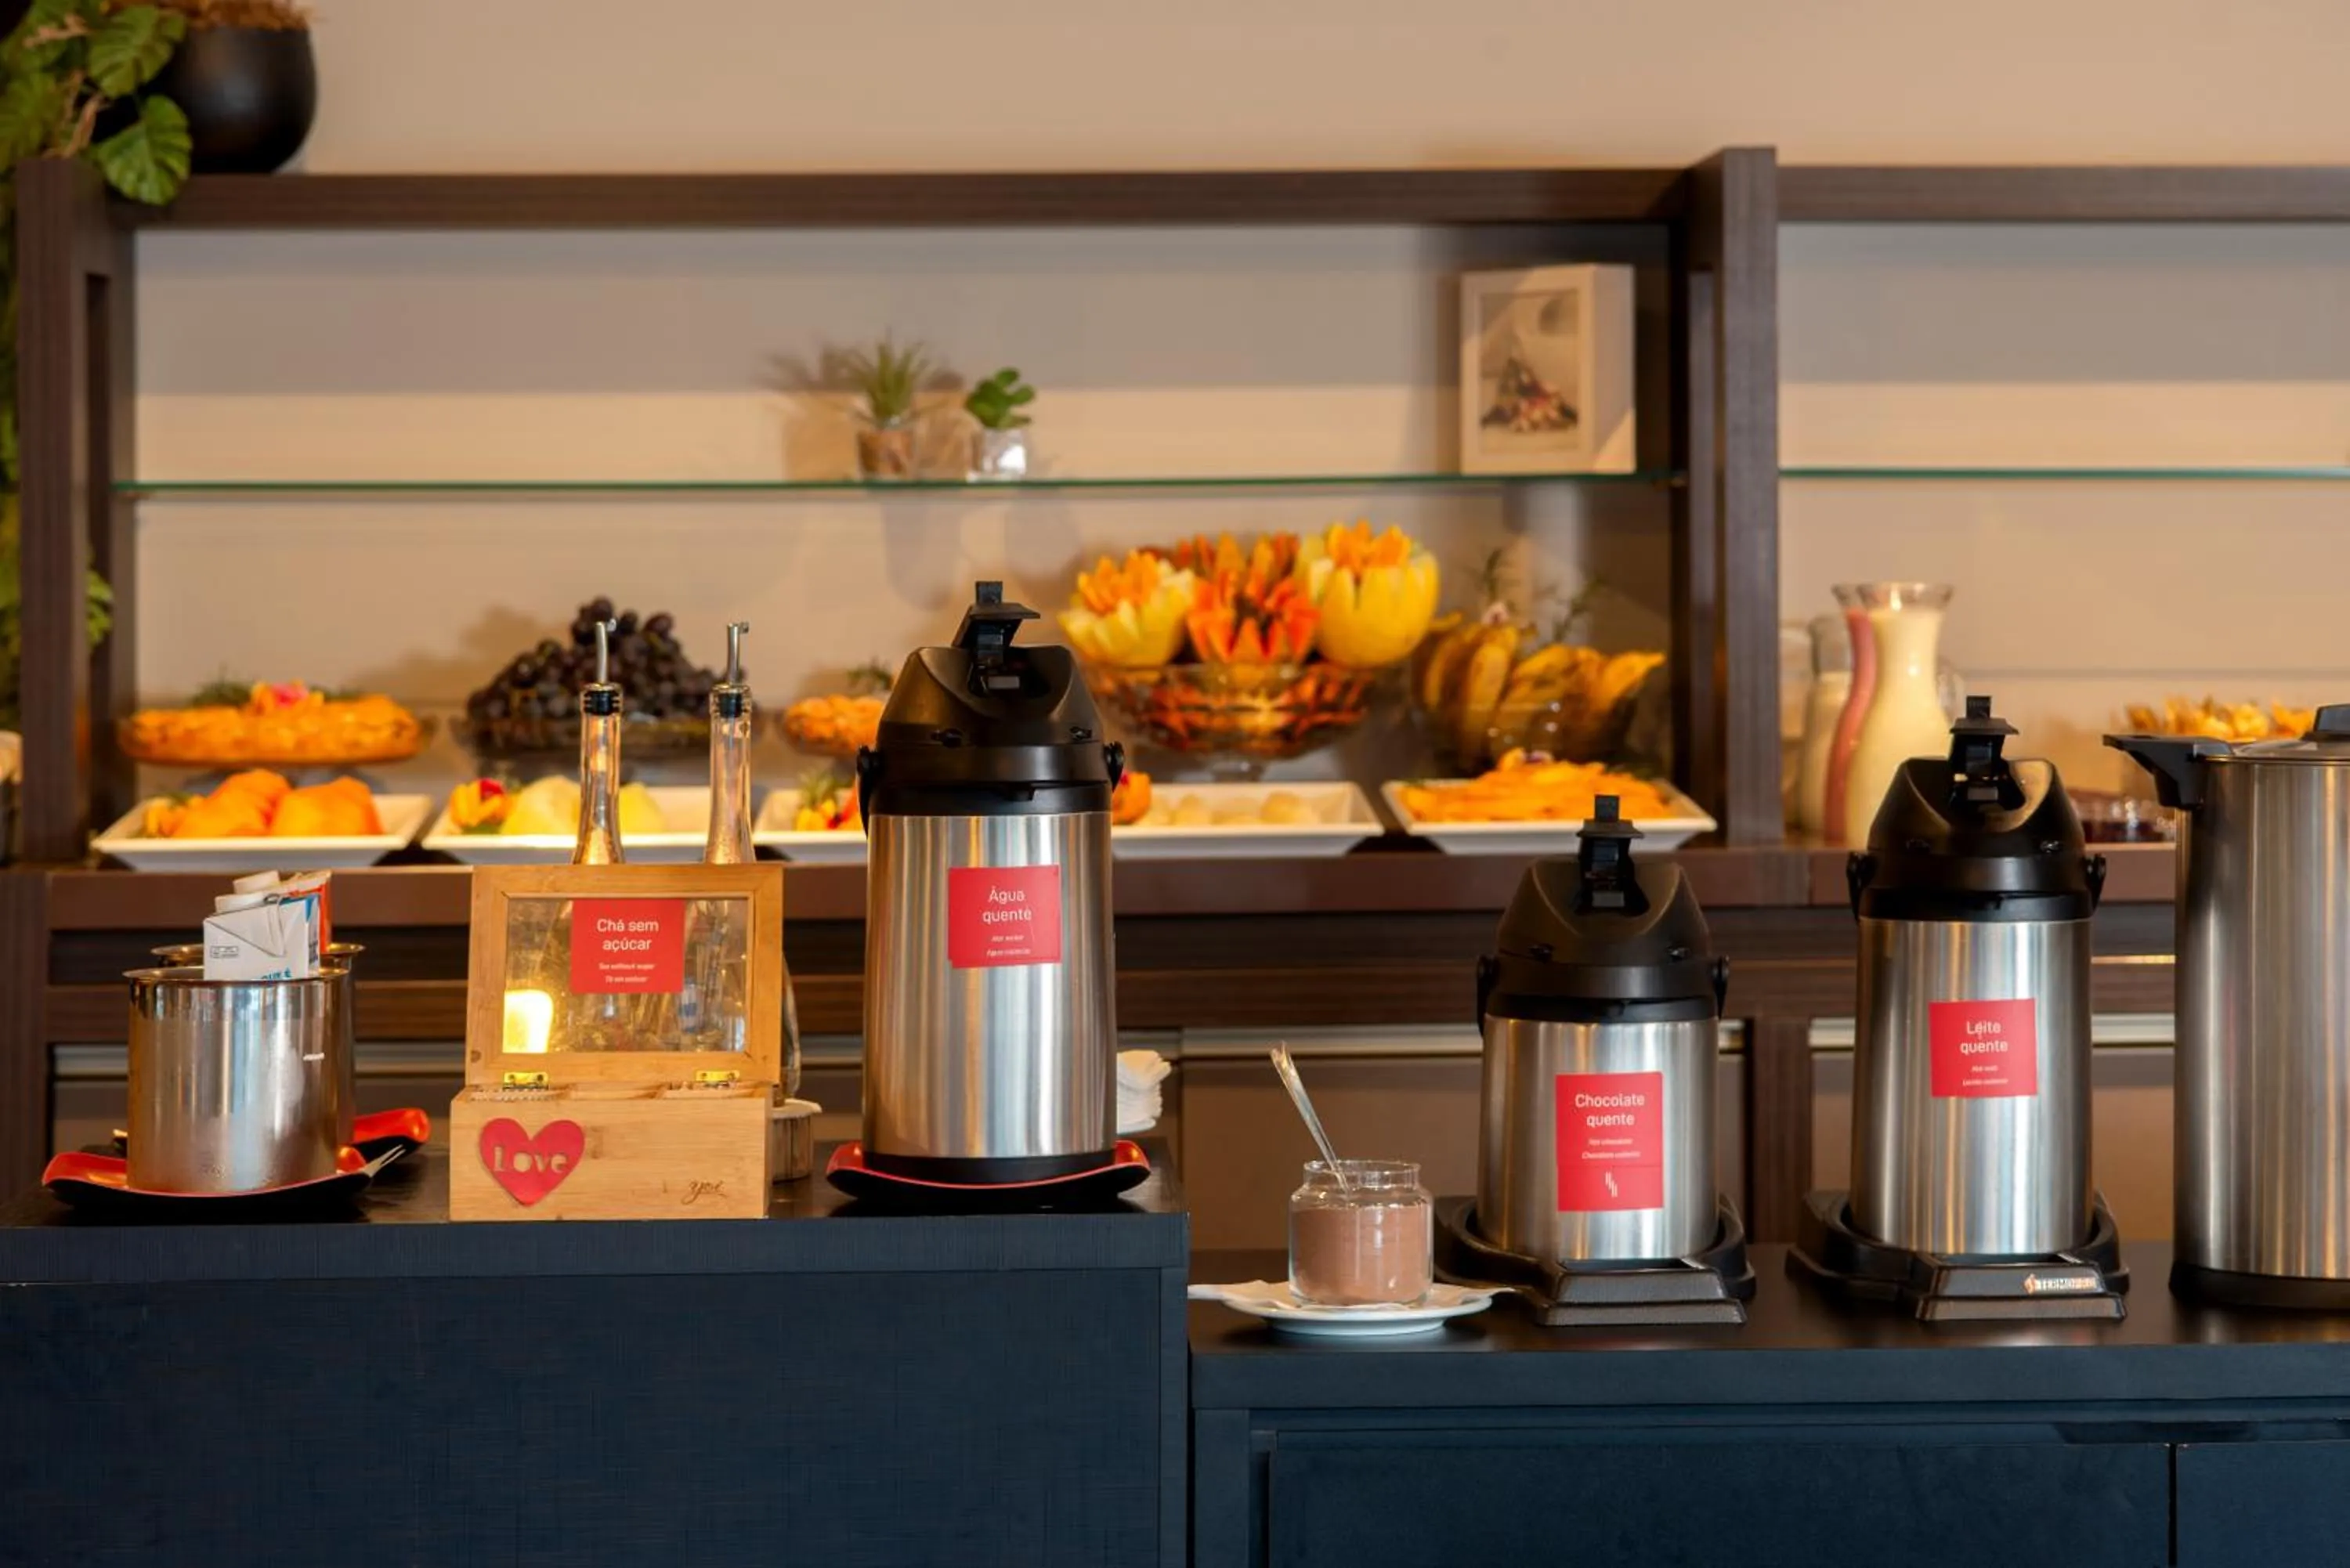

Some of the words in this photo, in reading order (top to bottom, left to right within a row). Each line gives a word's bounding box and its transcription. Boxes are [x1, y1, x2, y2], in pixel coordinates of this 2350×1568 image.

[989, 886, 1025, 904] Água
[982, 907, 1032, 924] quente
[597, 919, 624, 932] Chá
[628, 921, 659, 932] sem
[602, 938, 652, 952] açúcar
[1966, 1021, 2001, 1035] Leite
[1961, 1040, 2008, 1055] quente
[1575, 1093, 1645, 1107] Chocolate
[1586, 1113, 1635, 1128] quente
[493, 1146, 569, 1173] Love
